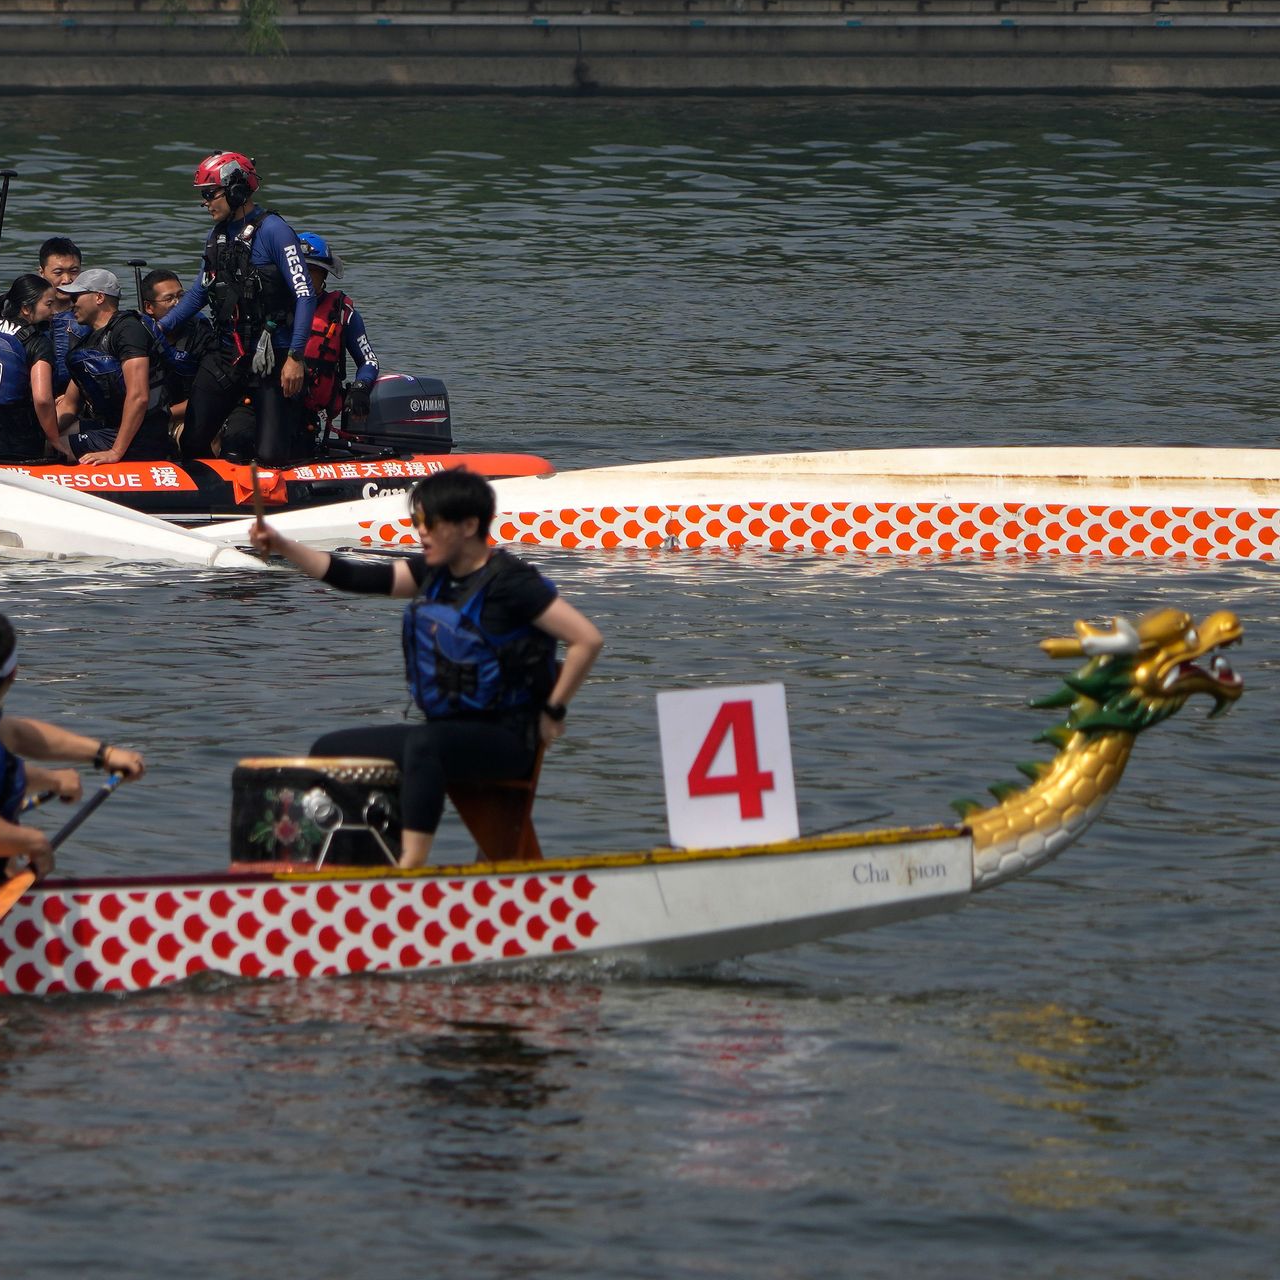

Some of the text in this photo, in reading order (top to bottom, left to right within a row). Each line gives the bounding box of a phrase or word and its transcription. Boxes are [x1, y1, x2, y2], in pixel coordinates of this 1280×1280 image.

[284, 244, 310, 298] RESCUE
[420, 398, 446, 412] YAMAHA
[42, 466, 180, 487] RESCUE 援
[294, 462, 446, 480] 通州蓝天救援队
[688, 700, 775, 820] 4
